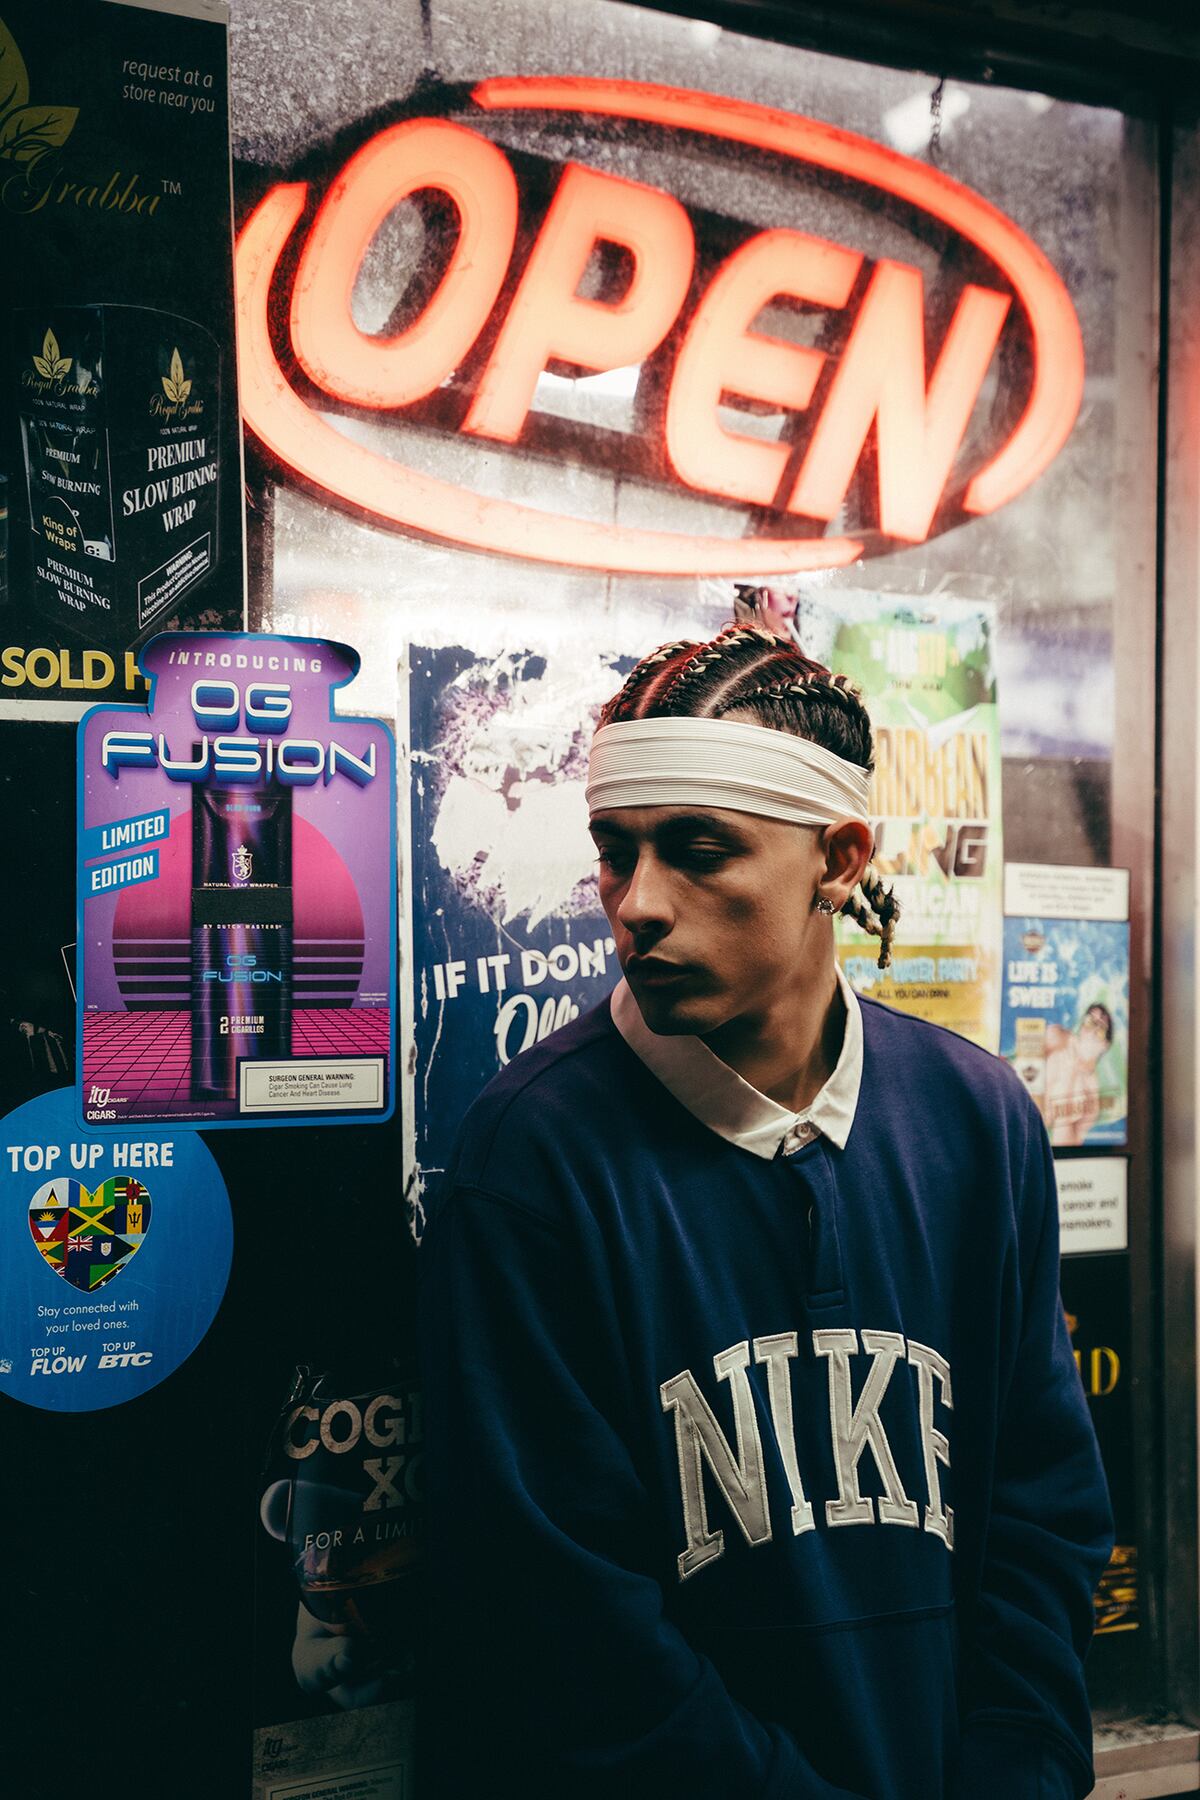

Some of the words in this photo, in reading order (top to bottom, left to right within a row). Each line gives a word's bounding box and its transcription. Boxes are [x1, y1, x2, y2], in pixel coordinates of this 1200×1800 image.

[122, 59, 181, 82] request
[184, 70, 199, 86] at
[203, 74, 213, 88] a
[122, 83, 156, 102] store
[159, 90, 188, 108] near
[191, 97, 215, 114] you
[1, 162, 161, 216] Grabba
[291, 117, 1010, 541] OPEN
[46, 447, 80, 464] PREMIUM
[147, 438, 206, 472] PREMIUM
[57, 476, 101, 496] BURNING
[122, 479, 170, 516] SLOW
[171, 462, 217, 498] BURNING
[42, 515, 64, 535] King
[66, 526, 78, 538] of
[162, 498, 197, 532] WRAP
[46, 529, 77, 552] Wraps
[47, 557, 93, 588] PREMIUM
[37, 565, 62, 586] SLOW
[63, 579, 111, 610] BURNING
[58, 589, 86, 611] WRAP
[1, 646, 116, 690] SOLD
[168, 651, 323, 674] INTRODUCING
[191, 680, 293, 732] OG
[102, 731, 377, 786] FUSION
[101, 815, 165, 851] LIMITED
[91, 855, 154, 892] EDITION
[226, 954, 257, 967] OG
[202, 970, 283, 982] FUSION
[433, 959, 466, 1001] IF
[477, 953, 510, 994] IT
[895, 990, 910, 999] YOU
[220, 1016, 230, 1034] 2
[231, 1016, 265, 1024] PREMIUM
[88, 1085, 111, 1108] itg
[269, 1083, 283, 1091] Cigar
[285, 1082, 308, 1090] Smoking
[339, 1081, 352, 1089] Lung
[269, 1090, 289, 1098] Cancer
[87, 1110, 117, 1120] CIGARS
[7, 1145, 61, 1173] TOP
[70, 1143, 104, 1170] UP
[113, 1142, 174, 1168] HERE
[37, 1305, 60, 1319] Stay
[63, 1300, 116, 1315] connected
[119, 1300, 139, 1311] with
[46, 1324, 69, 1336] your
[72, 1319, 100, 1331] loved
[103, 1320, 130, 1330] ones.
[30, 1347, 50, 1358] TOP
[52, 1346, 65, 1356] UP
[102, 1342, 121, 1352] TOP
[123, 1341, 136, 1350] UP
[30, 1355, 87, 1376] FLOW
[97, 1351, 153, 1369] BTC
[660, 1328, 954, 1582] NIKE
[305, 1529, 343, 1551] FOR
[353, 1526, 365, 1544] A
